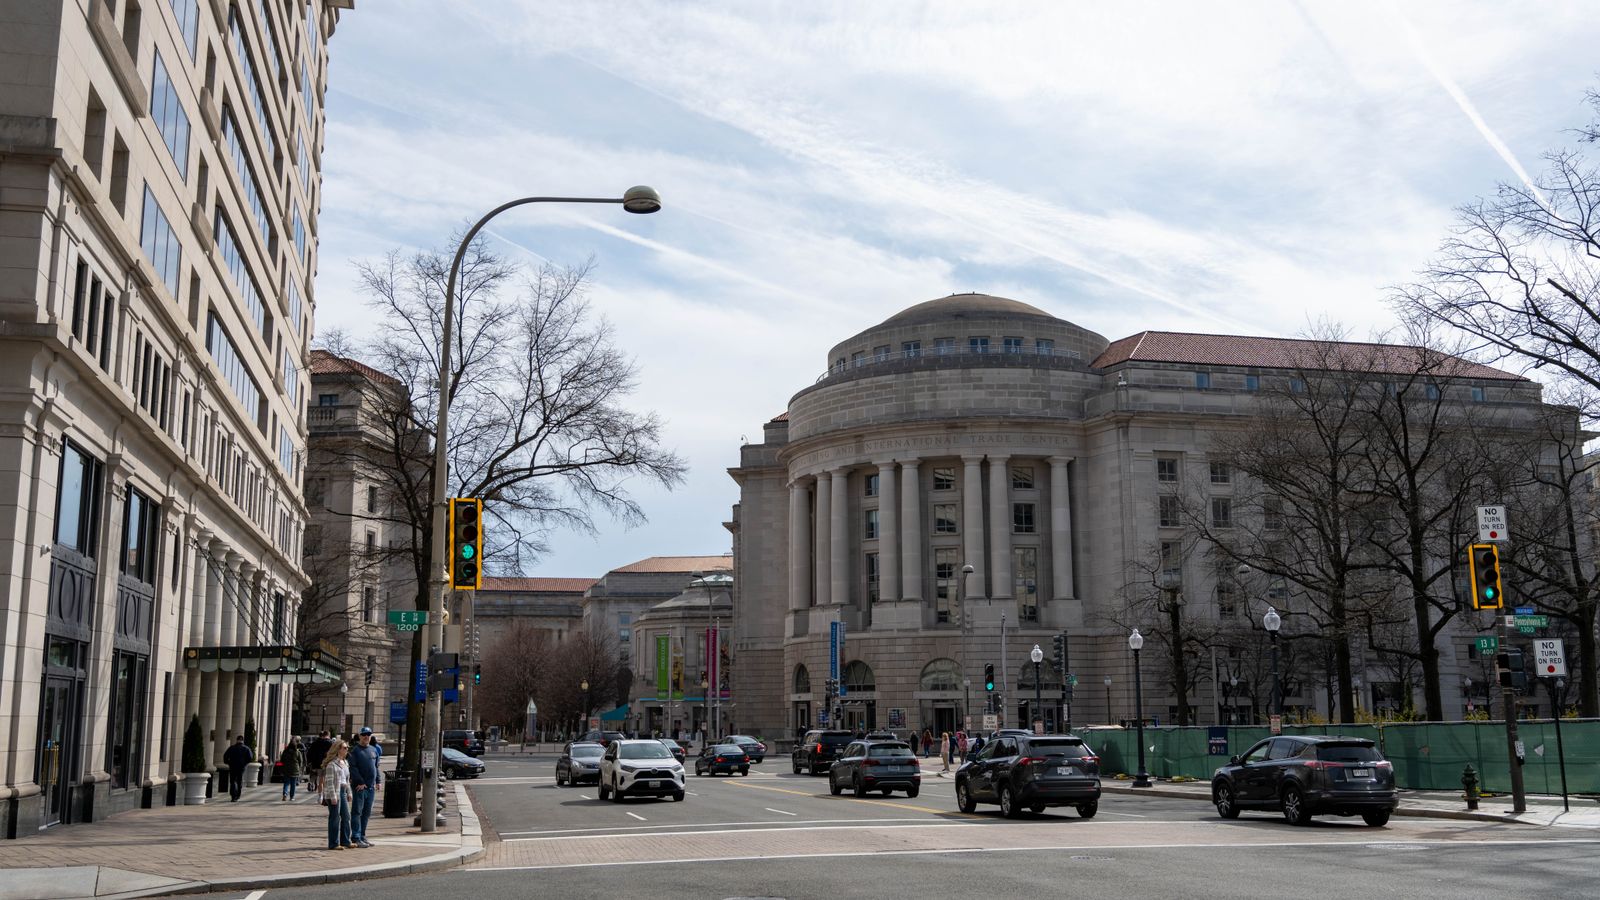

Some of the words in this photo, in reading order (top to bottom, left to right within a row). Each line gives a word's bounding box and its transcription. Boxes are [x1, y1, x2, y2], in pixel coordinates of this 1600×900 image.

[863, 433, 959, 450] NTERNATIONAL
[968, 434, 1011, 443] TRADE
[1023, 434, 1069, 445] CENTER
[401, 613, 406, 622] E
[1480, 638, 1487, 648] 13
